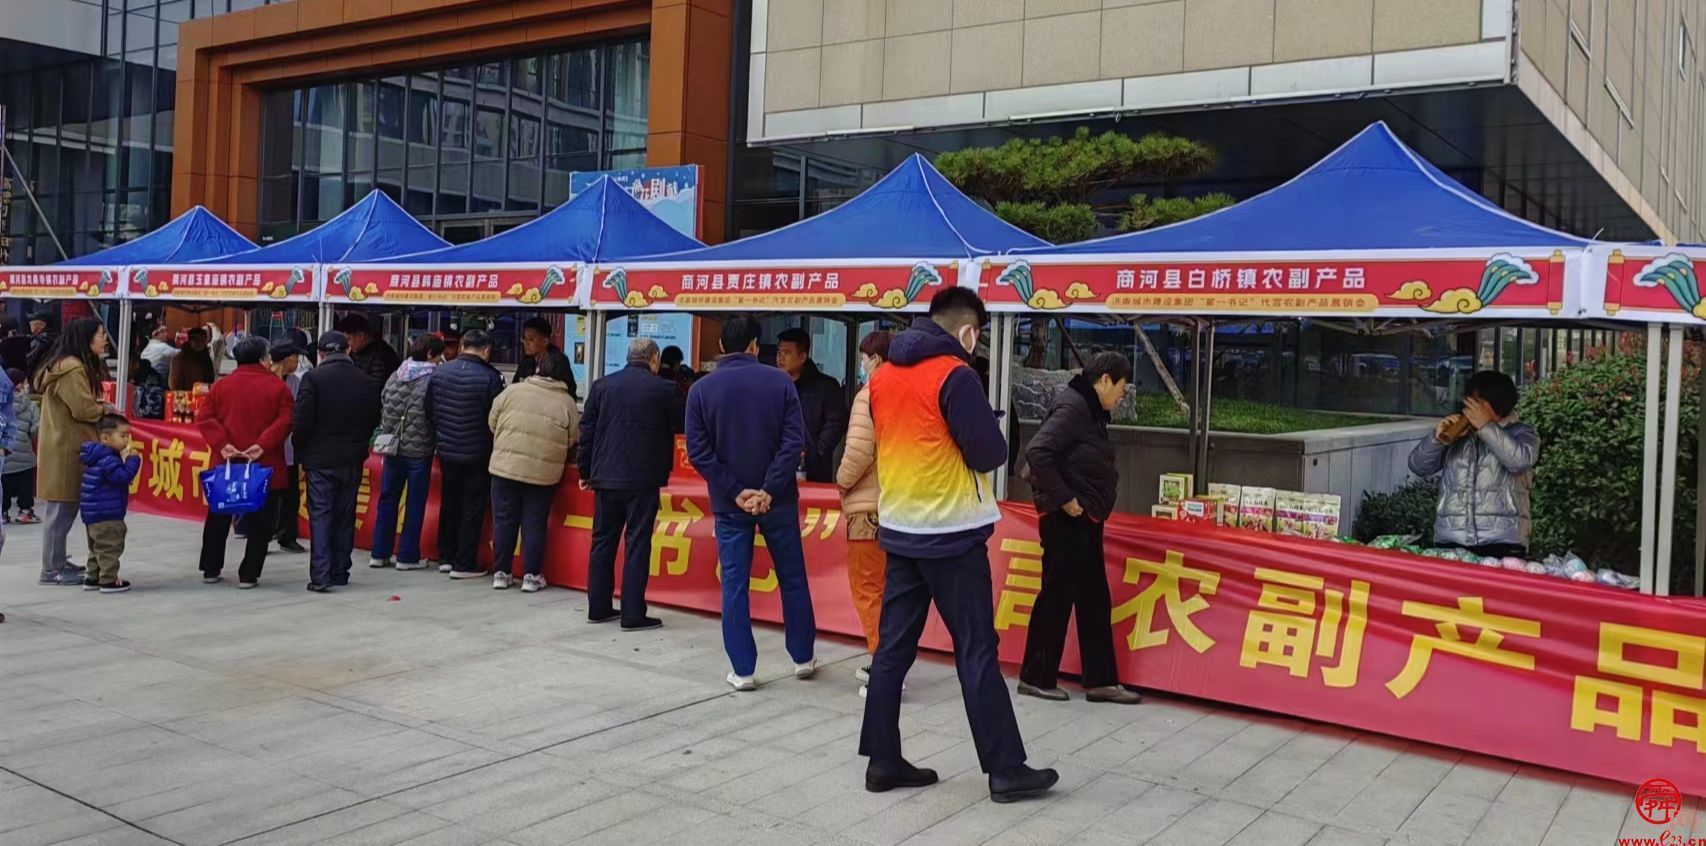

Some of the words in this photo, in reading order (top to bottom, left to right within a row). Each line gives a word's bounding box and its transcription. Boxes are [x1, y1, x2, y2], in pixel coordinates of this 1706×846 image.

[389, 274, 498, 288] 商河县韩庙镇农副产品
[682, 272, 839, 290] 商河县贾庄镇农副产品
[1116, 268, 1366, 288] 商河县白桥镇农副产品
